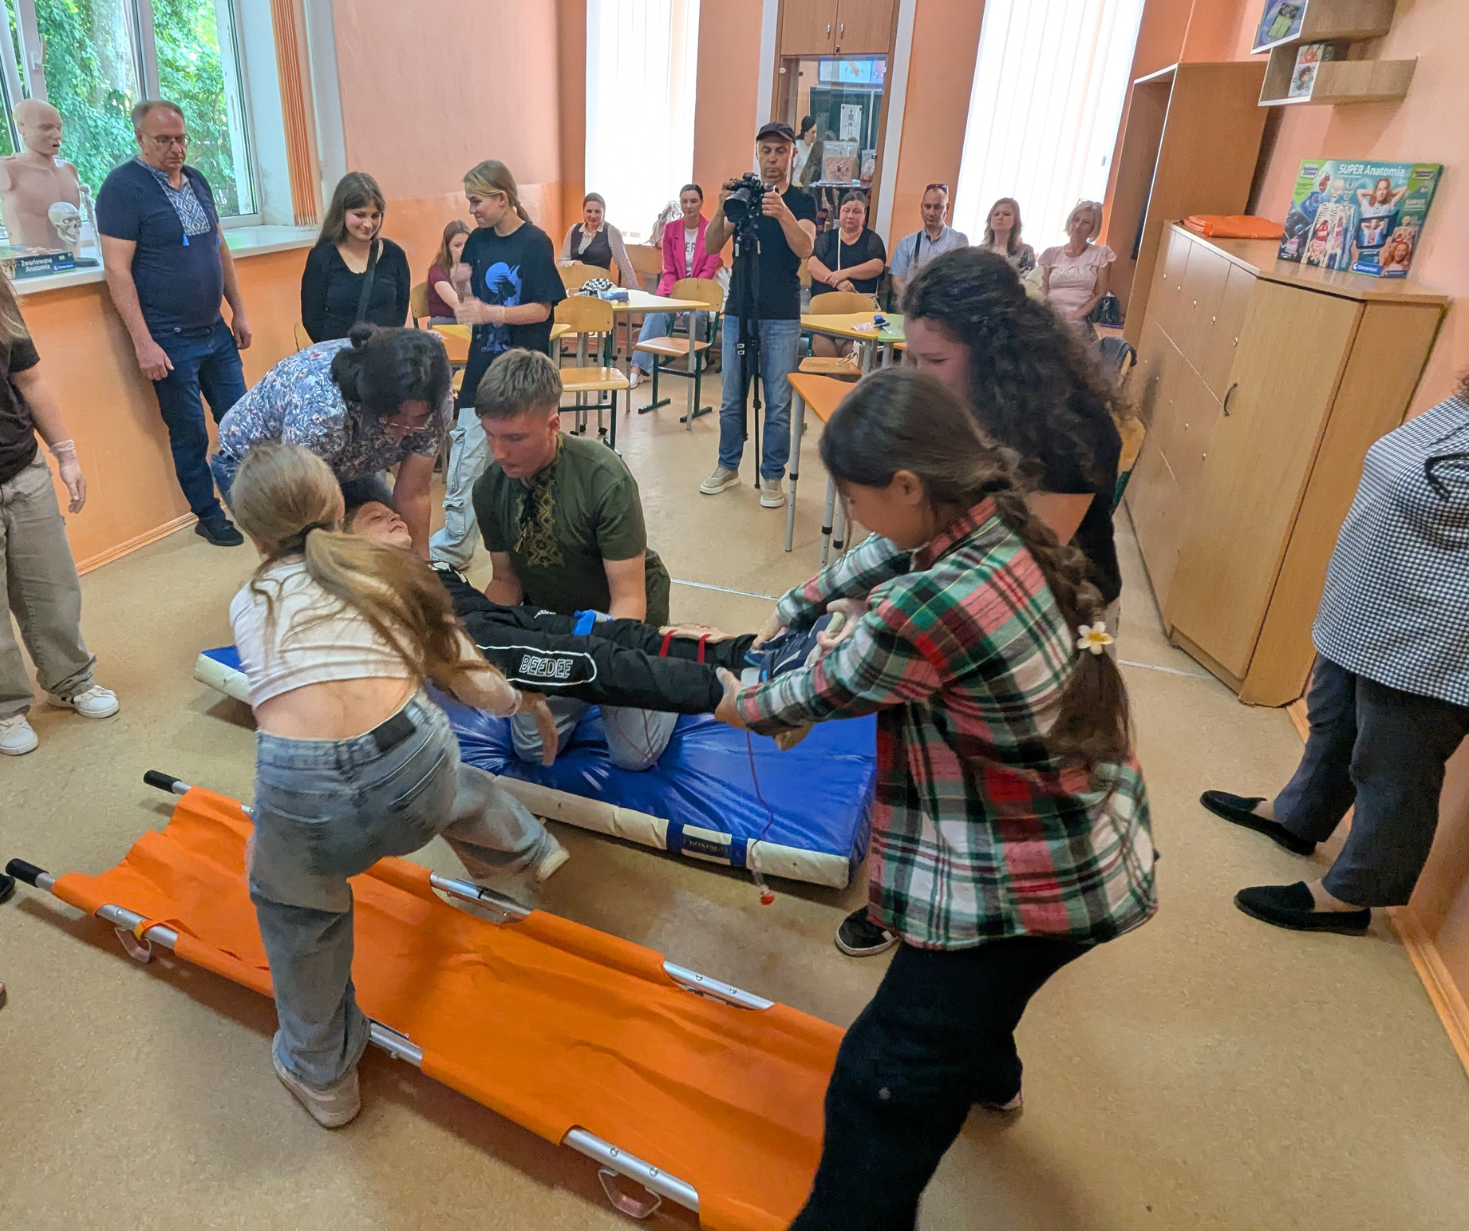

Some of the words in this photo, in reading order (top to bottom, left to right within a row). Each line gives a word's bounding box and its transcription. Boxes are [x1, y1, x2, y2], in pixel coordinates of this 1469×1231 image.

[1338, 164, 1365, 175] SUPER
[1364, 164, 1405, 177] Anatomia
[21, 257, 53, 267] Zwariowana
[25, 264, 51, 273] Anatomia
[519, 654, 574, 679] BEEDEE
